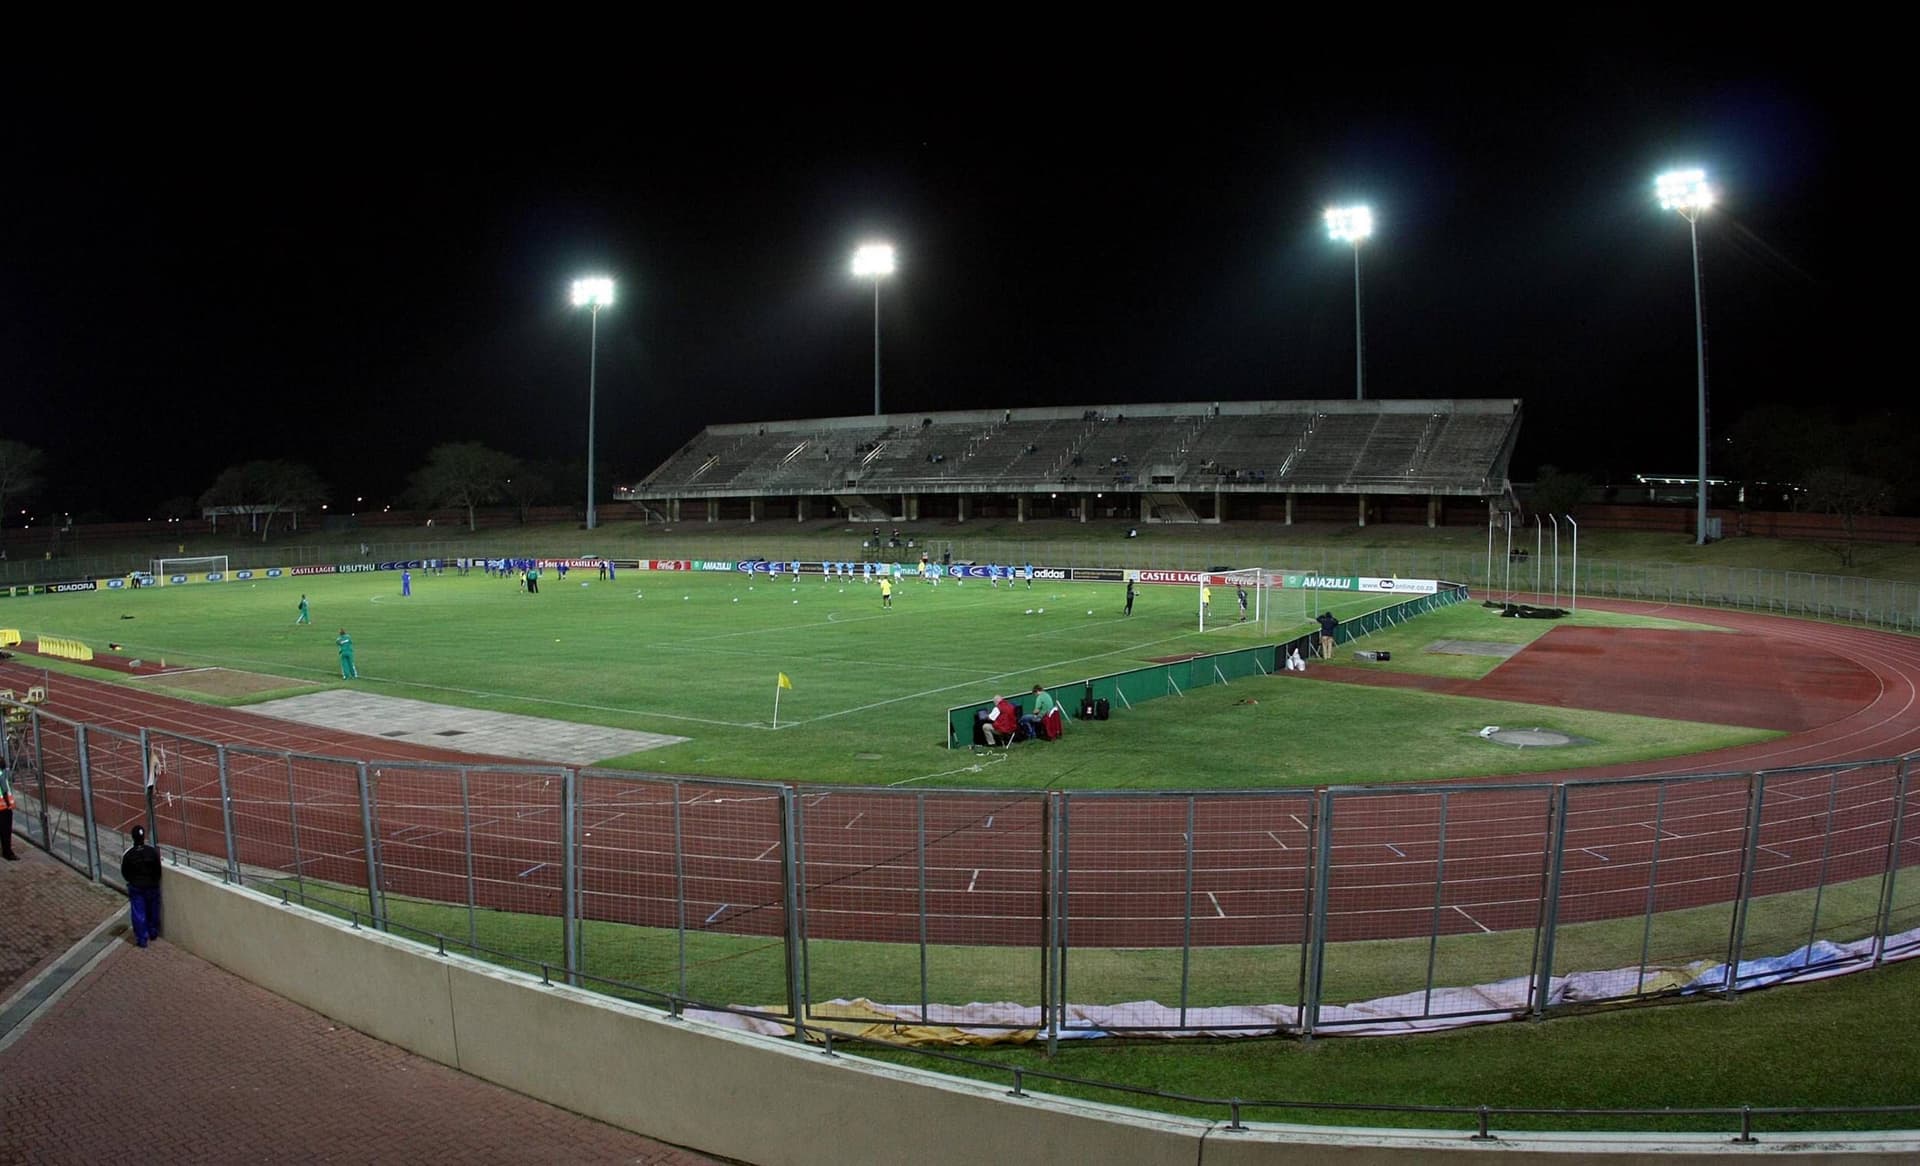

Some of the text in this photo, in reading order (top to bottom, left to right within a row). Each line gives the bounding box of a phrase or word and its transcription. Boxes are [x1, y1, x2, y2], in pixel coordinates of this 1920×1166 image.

[291, 565, 336, 575] CASTLE LAGER
[339, 563, 376, 573] USUTHU
[702, 562, 732, 570] AMAZULU
[1033, 569, 1065, 579] adidas
[1140, 572, 1177, 581] CASTLE
[57, 582, 95, 592] DIADORA
[1302, 577, 1351, 589] AMAZULU
